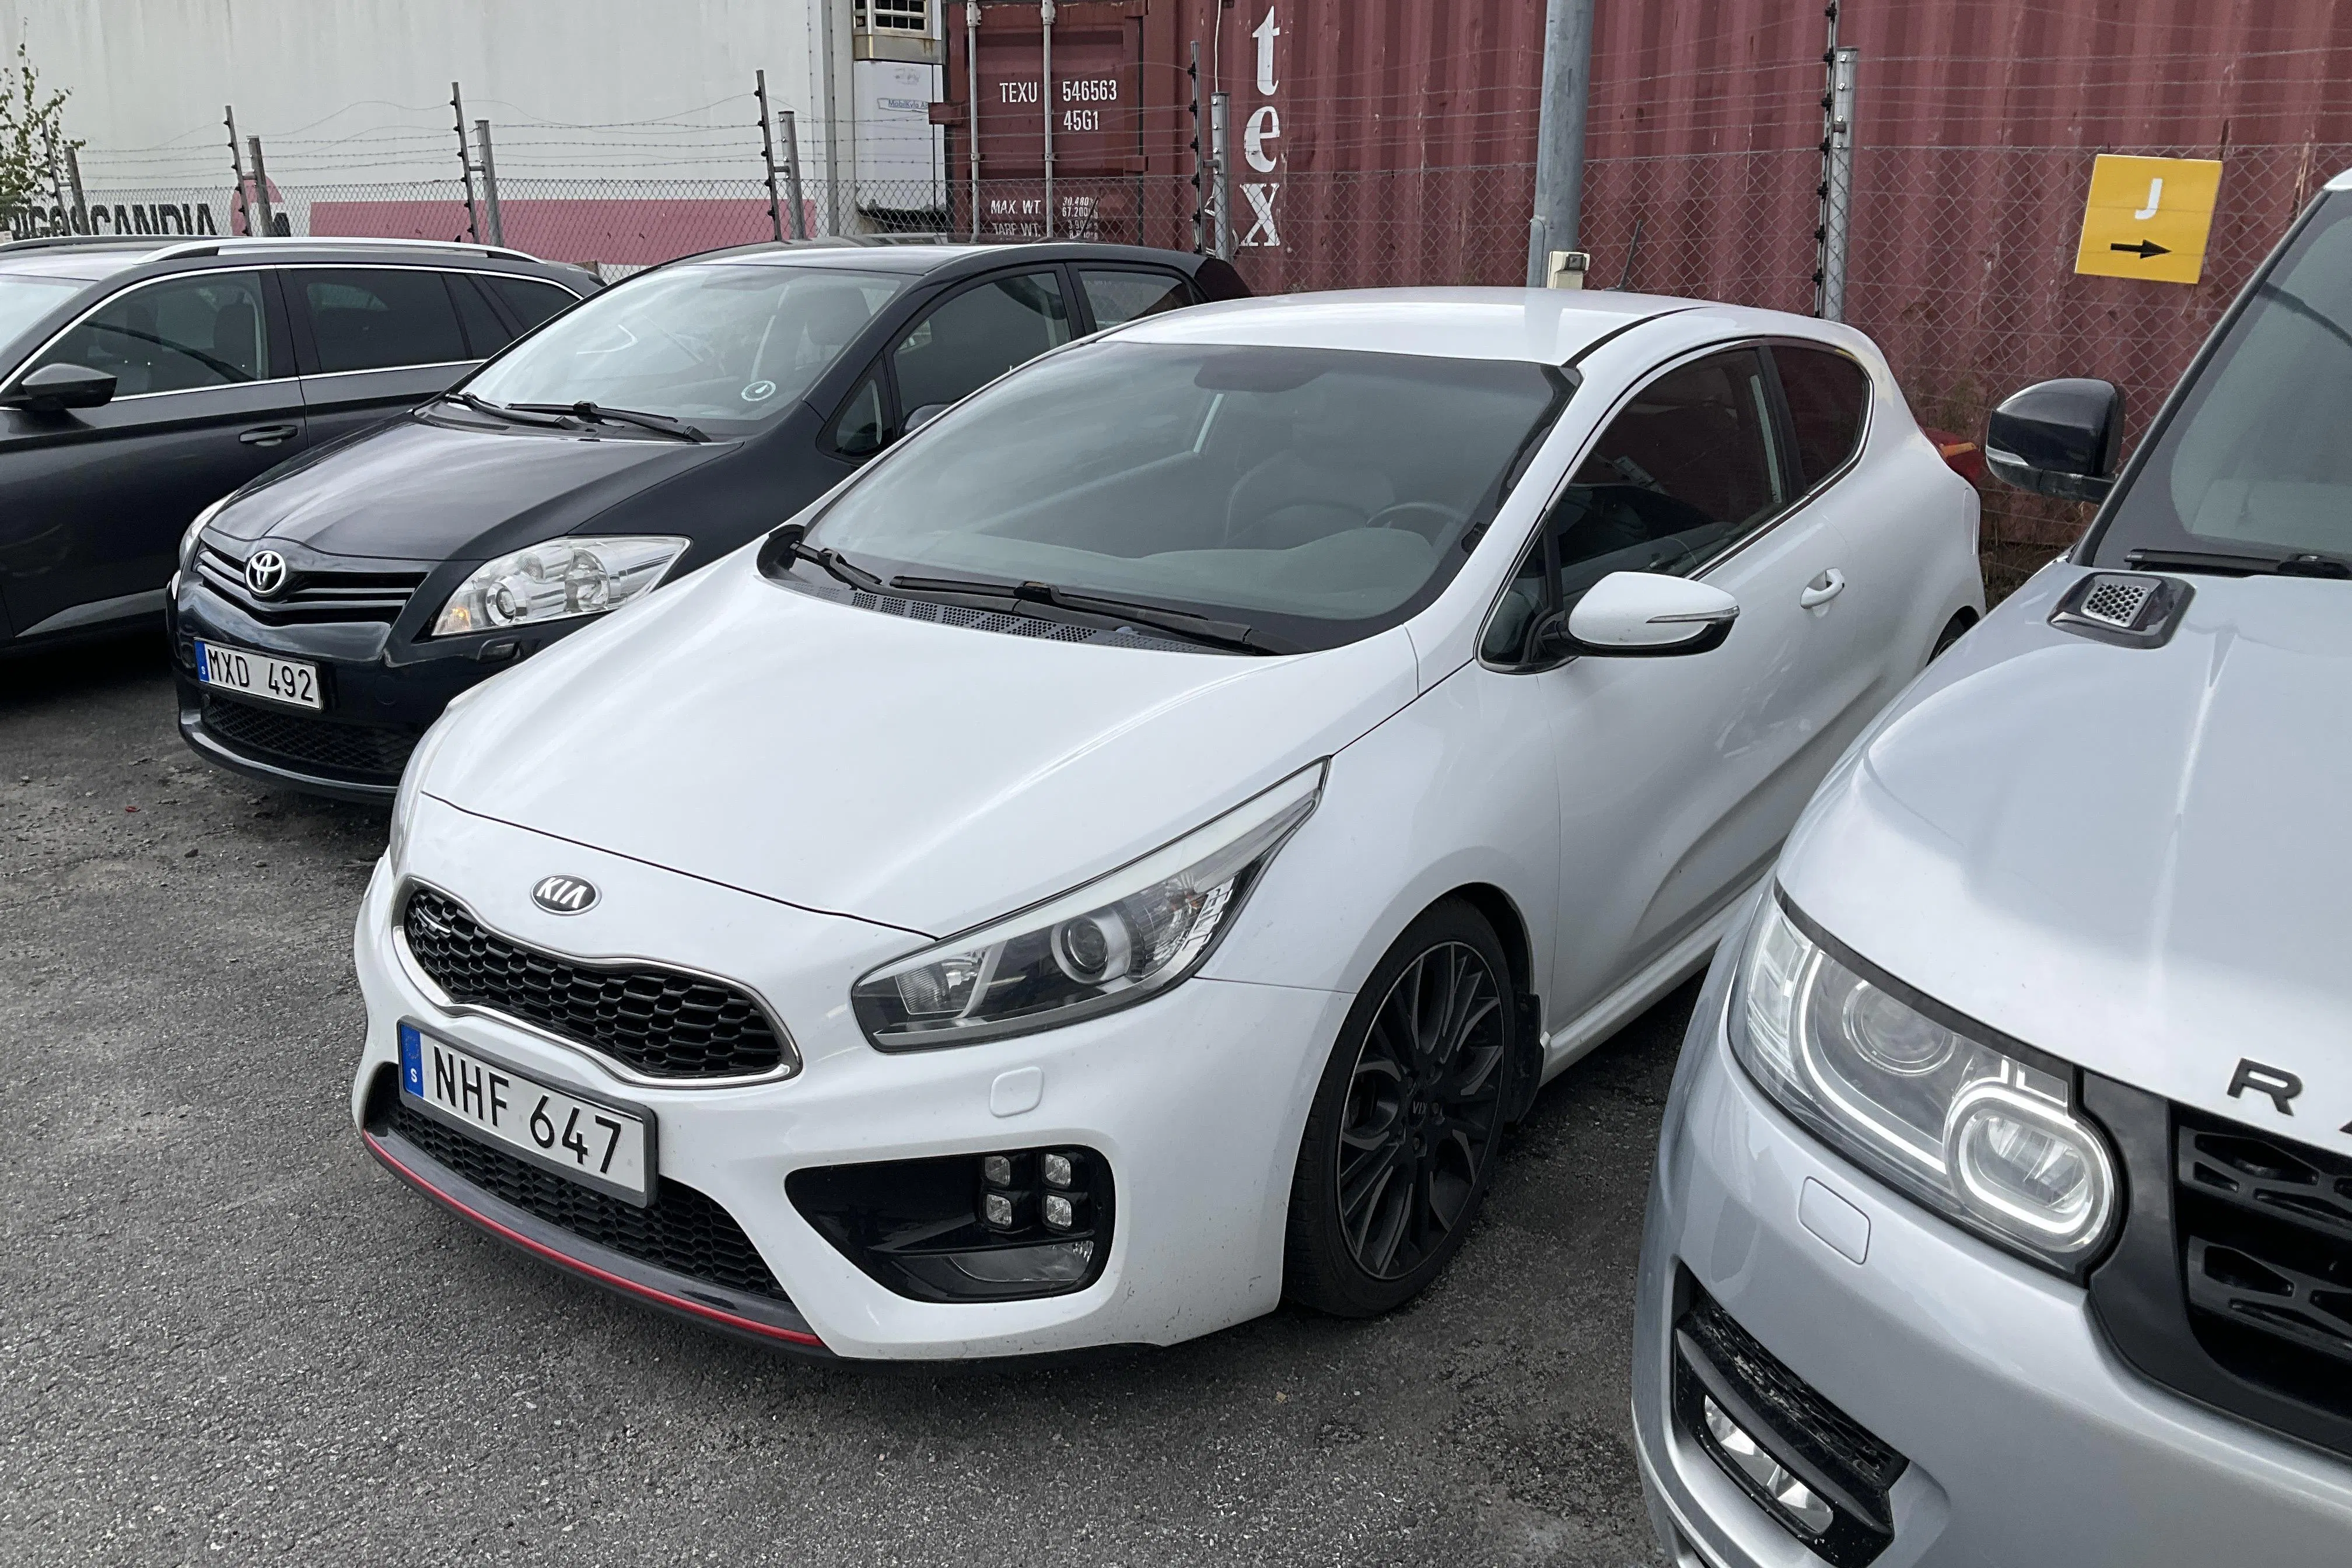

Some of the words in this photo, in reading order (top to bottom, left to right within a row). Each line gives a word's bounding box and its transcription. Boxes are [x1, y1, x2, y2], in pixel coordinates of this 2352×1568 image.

[999, 82, 1037, 103] TEXU
[1062, 79, 1117, 102] 546563
[1063, 109, 1098, 130] 45G1
[2135, 178, 2162, 220] J
[207, 648, 250, 688] MXD
[268, 662, 313, 702] 492
[537, 877, 587, 909] KIA
[410, 1068, 418, 1083] S
[434, 1045, 510, 1127] NHF
[530, 1095, 622, 1174] 647
